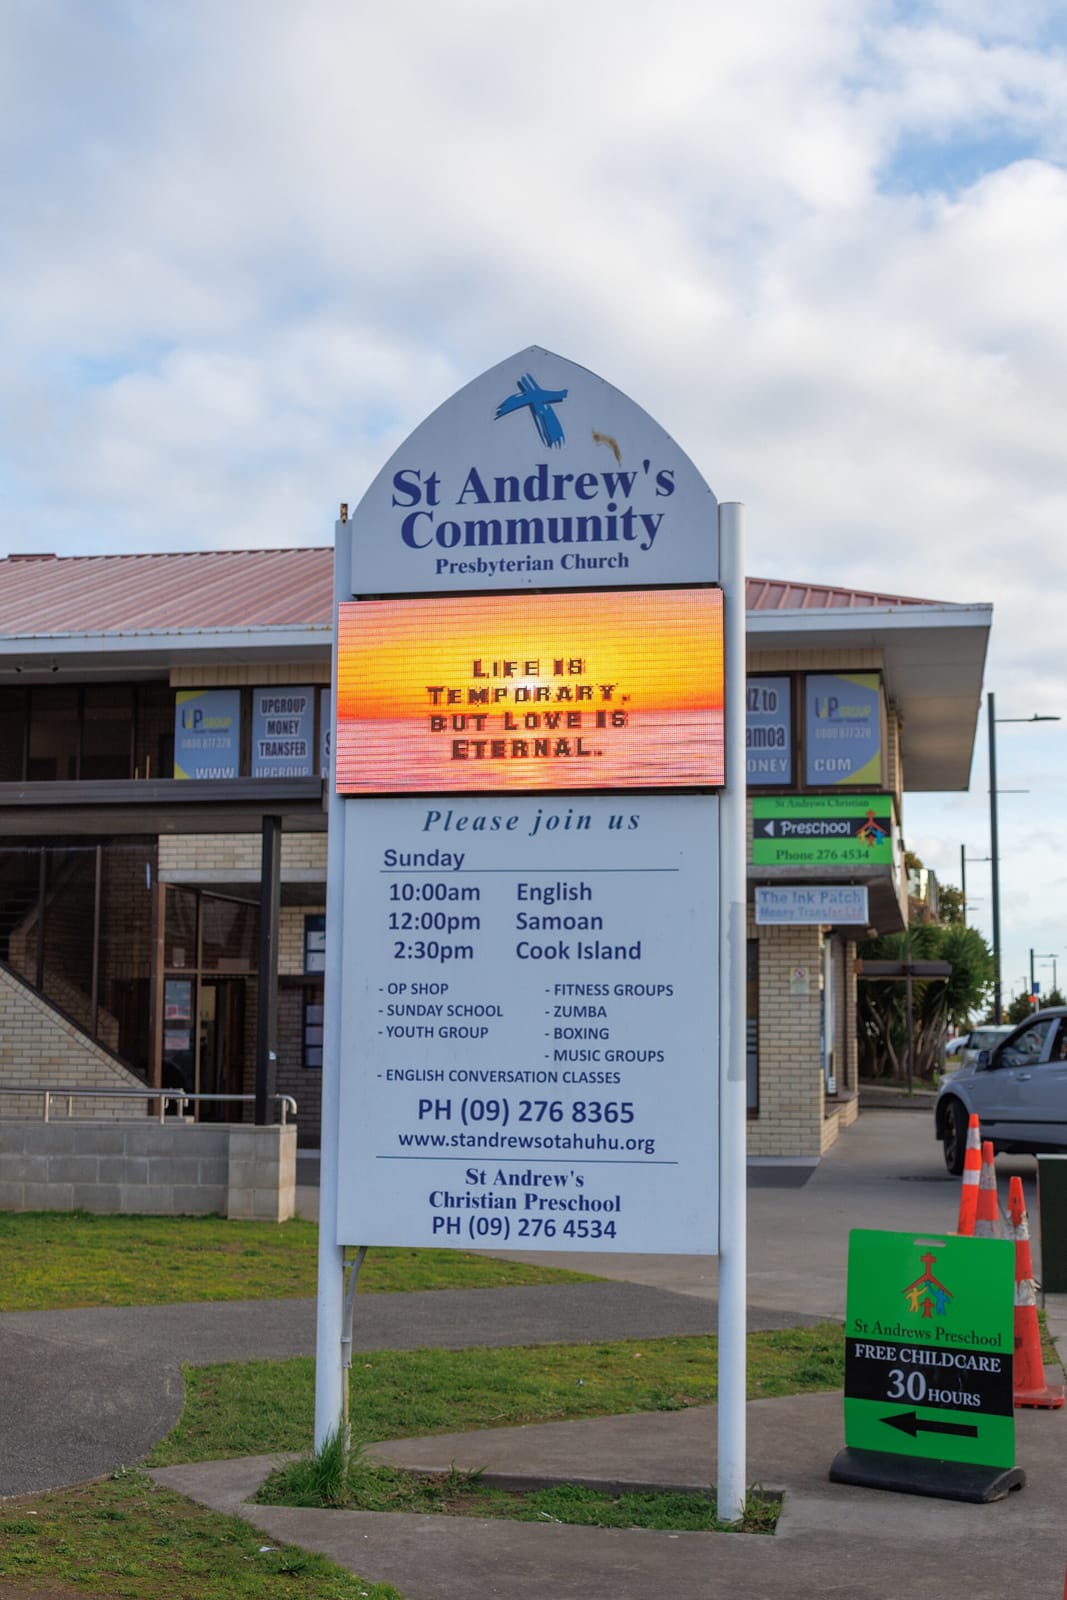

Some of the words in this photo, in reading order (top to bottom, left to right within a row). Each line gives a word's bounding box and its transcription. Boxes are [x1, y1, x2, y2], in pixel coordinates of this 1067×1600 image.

[392, 469, 440, 507] St
[456, 459, 675, 505] Andrew's
[401, 503, 664, 551] Community
[435, 555, 554, 577] Presbyterian
[560, 552, 629, 570] Church
[473, 658, 540, 678] LIFE
[554, 658, 586, 677] IS
[262, 698, 306, 714] UPGROUP
[762, 689, 777, 712] to
[267, 719, 300, 735] MONEY
[431, 712, 488, 732] BUT
[504, 710, 581, 730] LOVE
[596, 710, 628, 728] IS
[746, 727, 785, 748] amoa
[259, 742, 306, 757] TRANSFER
[747, 759, 788, 772] ONEY
[422, 810, 520, 832] Please
[528, 808, 593, 836] join
[608, 812, 640, 830] us
[780, 821, 851, 836] Preschool
[384, 849, 465, 870] Sunday
[776, 849, 813, 860] Phone
[816, 850, 838, 860] 276
[840, 849, 869, 859] 4534
[388, 883, 480, 901] 10:00am
[517, 882, 592, 905] English
[760, 891, 787, 904] The
[793, 891, 814, 904] Ink
[820, 890, 861, 904] Patch
[388, 912, 480, 934] 12:00pm
[516, 912, 603, 930] Samoan
[393, 941, 474, 964] 2:30pm
[516, 940, 570, 960] Cook
[578, 940, 641, 960] Island
[388, 983, 407, 996] OP
[411, 983, 448, 996] SHOP
[554, 984, 610, 996] FITNESS
[614, 984, 674, 997] GROUPS
[387, 1004, 444, 1017] SUNDAY
[447, 1005, 503, 1018] SCHOOL
[554, 1006, 607, 1018] ZUMBA
[386, 1026, 434, 1038] YOUTH
[438, 1026, 488, 1039] GROUP
[554, 1028, 610, 1040] BOXING
[554, 1050, 600, 1062] MUSIC
[604, 1050, 664, 1063] GROUPS
[386, 1069, 444, 1082] ENGLISH
[449, 1070, 558, 1084] CONVERSATION
[562, 1071, 620, 1084] CLASSES
[418, 1099, 452, 1120] PH
[461, 1098, 510, 1126] (09)
[518, 1100, 564, 1122] 276
[572, 1101, 634, 1124] 8365
[398, 1132, 656, 1154] www.standrewsotahuhu.org
[466, 1168, 486, 1186] St
[493, 1169, 584, 1188] Andrew's
[429, 1190, 517, 1210] Christian
[524, 1192, 622, 1212] Preschool
[432, 1216, 460, 1234] PH
[469, 1216, 510, 1240] (09)
[518, 1218, 556, 1238] 276
[563, 1219, 616, 1239] 4534
[854, 1318, 869, 1334] St
[872, 1321, 932, 1340] Andrews
[935, 1326, 1002, 1347] Preschool
[855, 1343, 896, 1362] FREE
[900, 1348, 1002, 1373] CHILDCARE
[887, 1369, 926, 1401] 30
[928, 1388, 981, 1407] HOURS
